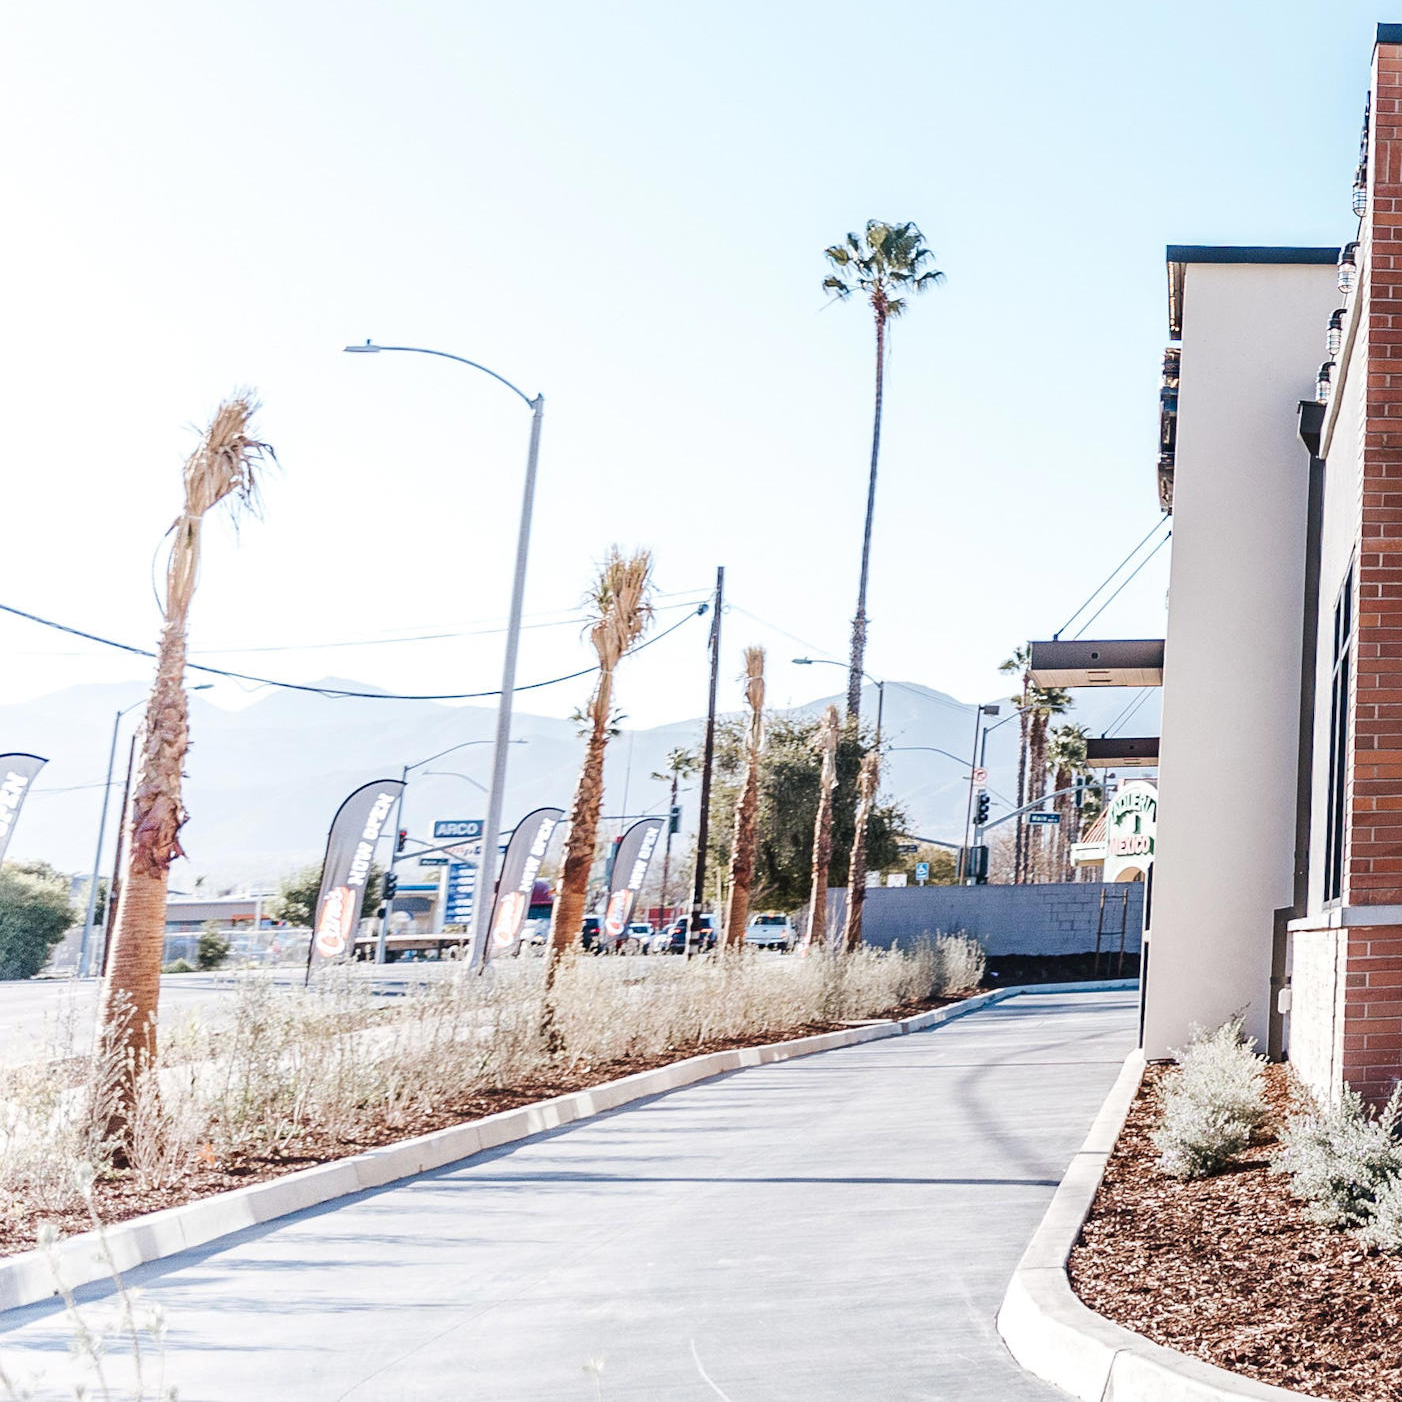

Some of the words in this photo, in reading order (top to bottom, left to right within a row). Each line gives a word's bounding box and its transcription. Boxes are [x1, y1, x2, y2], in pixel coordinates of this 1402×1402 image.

[435, 822, 479, 836] ARCO
[347, 841, 374, 886] NOW
[362, 792, 396, 840] OPEN
[1110, 837, 1154, 856] MEXICO
